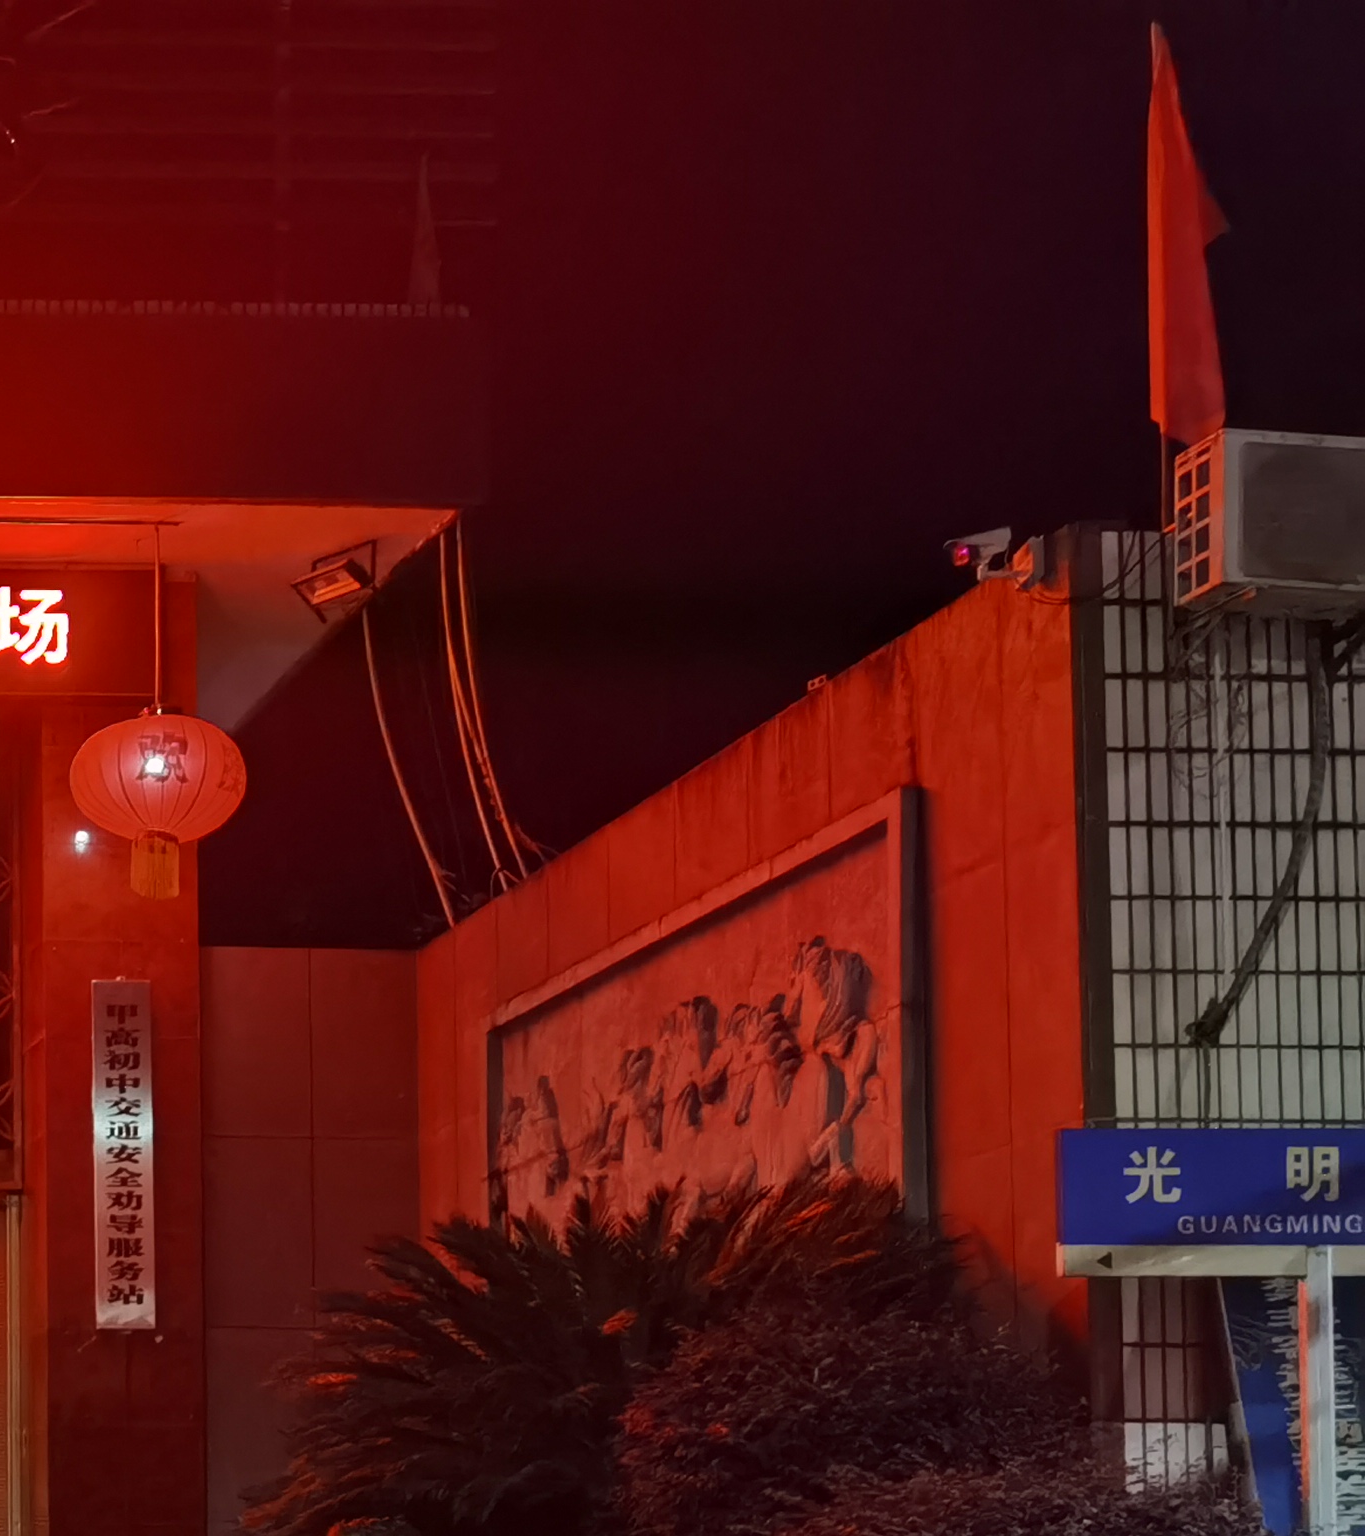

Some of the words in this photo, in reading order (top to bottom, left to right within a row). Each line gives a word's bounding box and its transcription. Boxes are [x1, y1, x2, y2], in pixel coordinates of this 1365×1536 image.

[103, 1003, 144, 1306] 甲高初中交通安全劝导服务站
[1123, 1146, 1340, 1204] 光明
[1177, 1213, 1365, 1235] GUANGMING
